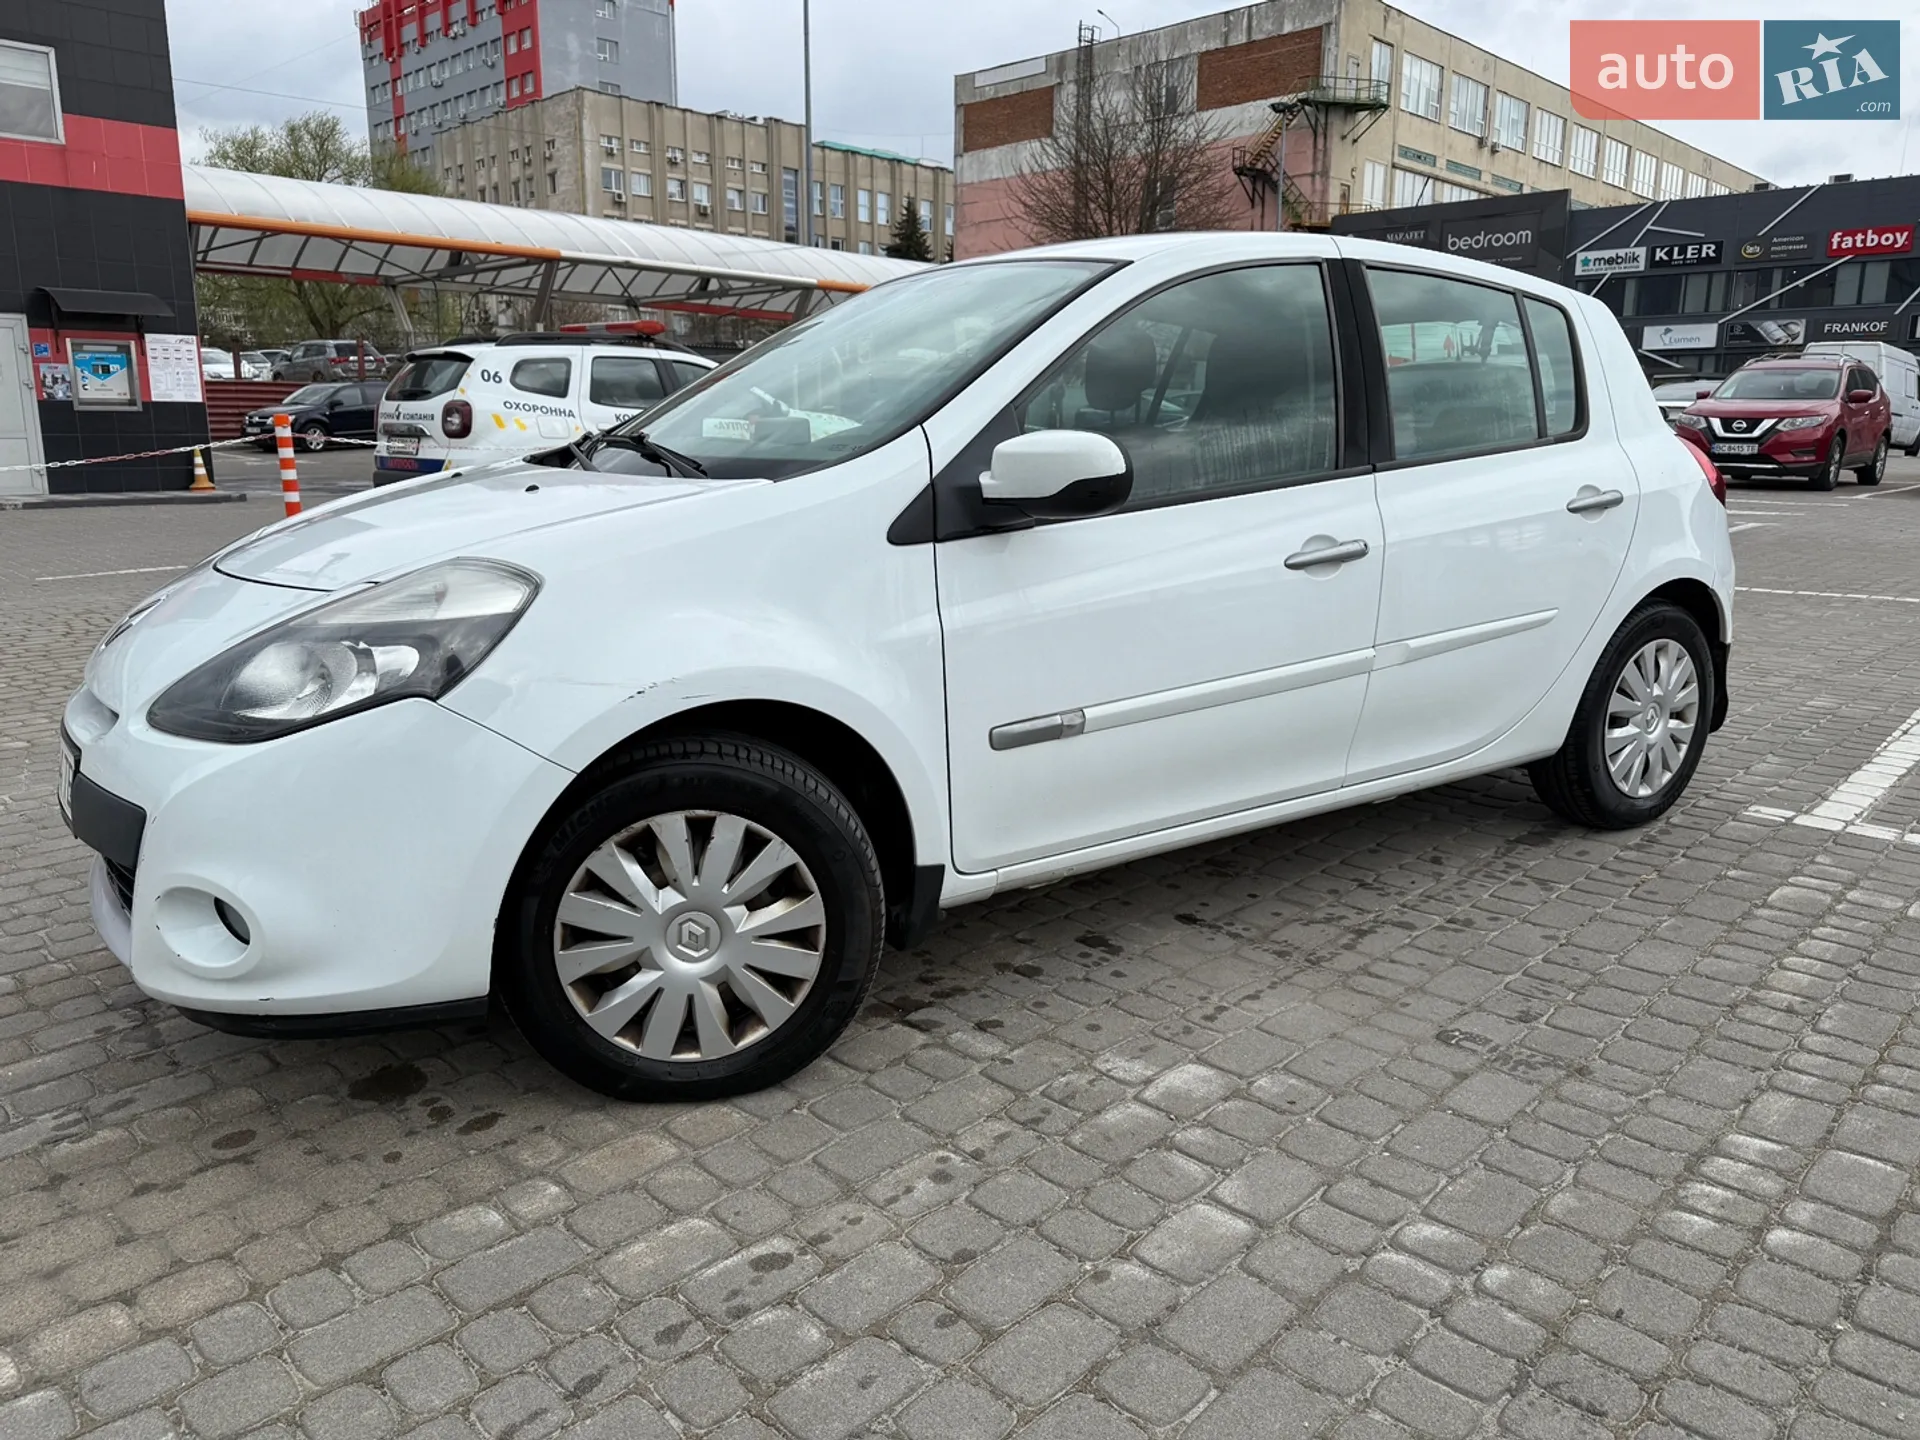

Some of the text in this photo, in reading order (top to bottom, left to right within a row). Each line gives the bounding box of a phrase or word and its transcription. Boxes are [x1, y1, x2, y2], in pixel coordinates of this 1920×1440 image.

[1447, 230, 1532, 251] bedroom
[1772, 235, 1805, 243] American
[1831, 229, 1909, 250] fatboy
[1593, 251, 1640, 267] meblik
[1654, 243, 1717, 261] KLER
[1823, 321, 1889, 334] FRANKOF
[1669, 336, 1701, 345] Lumen
[480, 369, 503, 385] 06
[503, 400, 575, 419] ОХОРОННА
